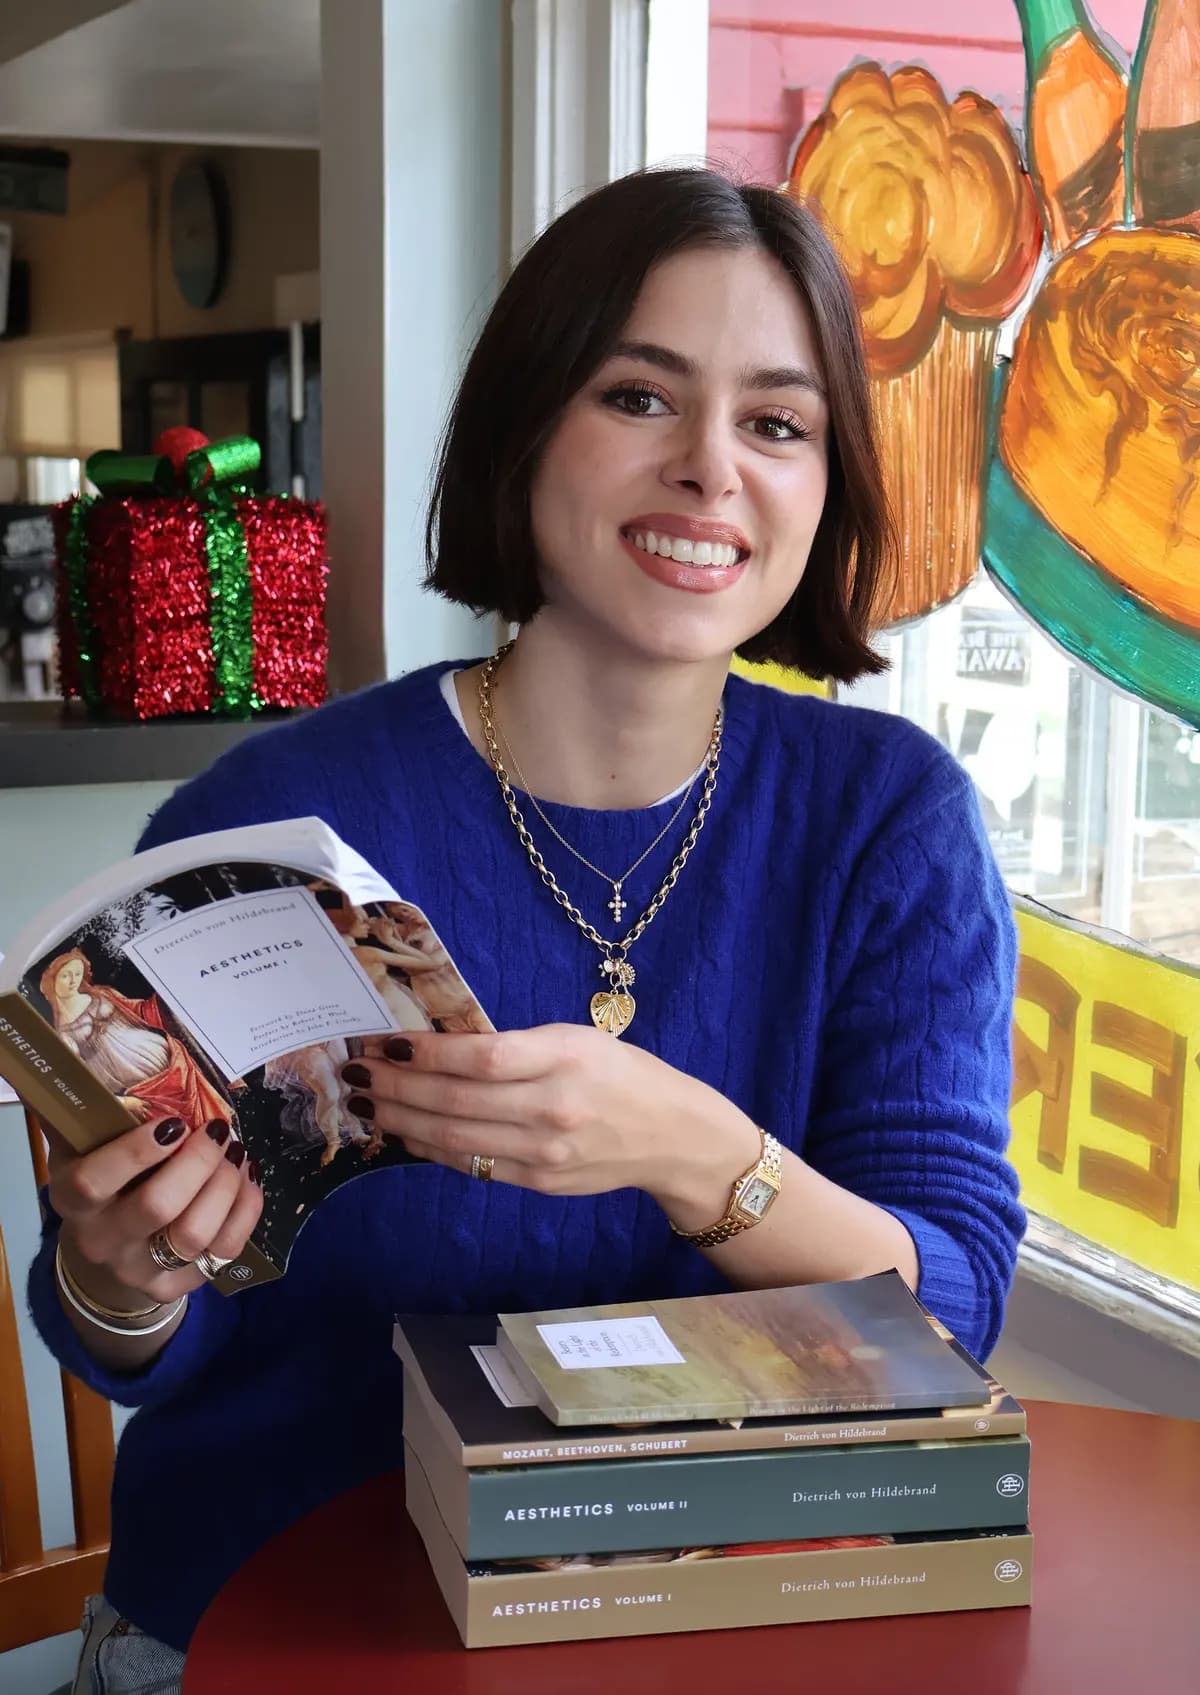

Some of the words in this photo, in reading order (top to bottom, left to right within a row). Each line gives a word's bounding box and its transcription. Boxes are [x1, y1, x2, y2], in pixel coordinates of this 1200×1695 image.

[154, 928, 202, 954] Dietrich
[205, 920, 226, 931] von
[229, 903, 296, 922] Hildebrand
[200, 940, 303, 978] AESTHETICS
[233, 962, 279, 979] VOLUME
[54, 1078, 82, 1106] VOLUME
[503, 1449, 553, 1459] MOZART,
[557, 1444, 626, 1457] BEETHOVEN,
[630, 1439, 687, 1451] SCHUBERT
[784, 1431, 819, 1441] Dietrich
[839, 1427, 887, 1438] Hildebrand
[504, 1503, 614, 1521] AESTHETICS
[627, 1501, 675, 1512] VOLUME
[679, 1500, 688, 1509] II
[792, 1489, 841, 1503] Dietrich
[846, 1491, 866, 1499] von
[871, 1484, 937, 1499] Hildebrand
[492, 1597, 601, 1617] AESTHETICS
[615, 1594, 663, 1606] VOLUME
[667, 1593, 672, 1601] I
[781, 1580, 830, 1593] Dietrich
[835, 1580, 855, 1589] von
[860, 1572, 926, 1587] Hildebrand
